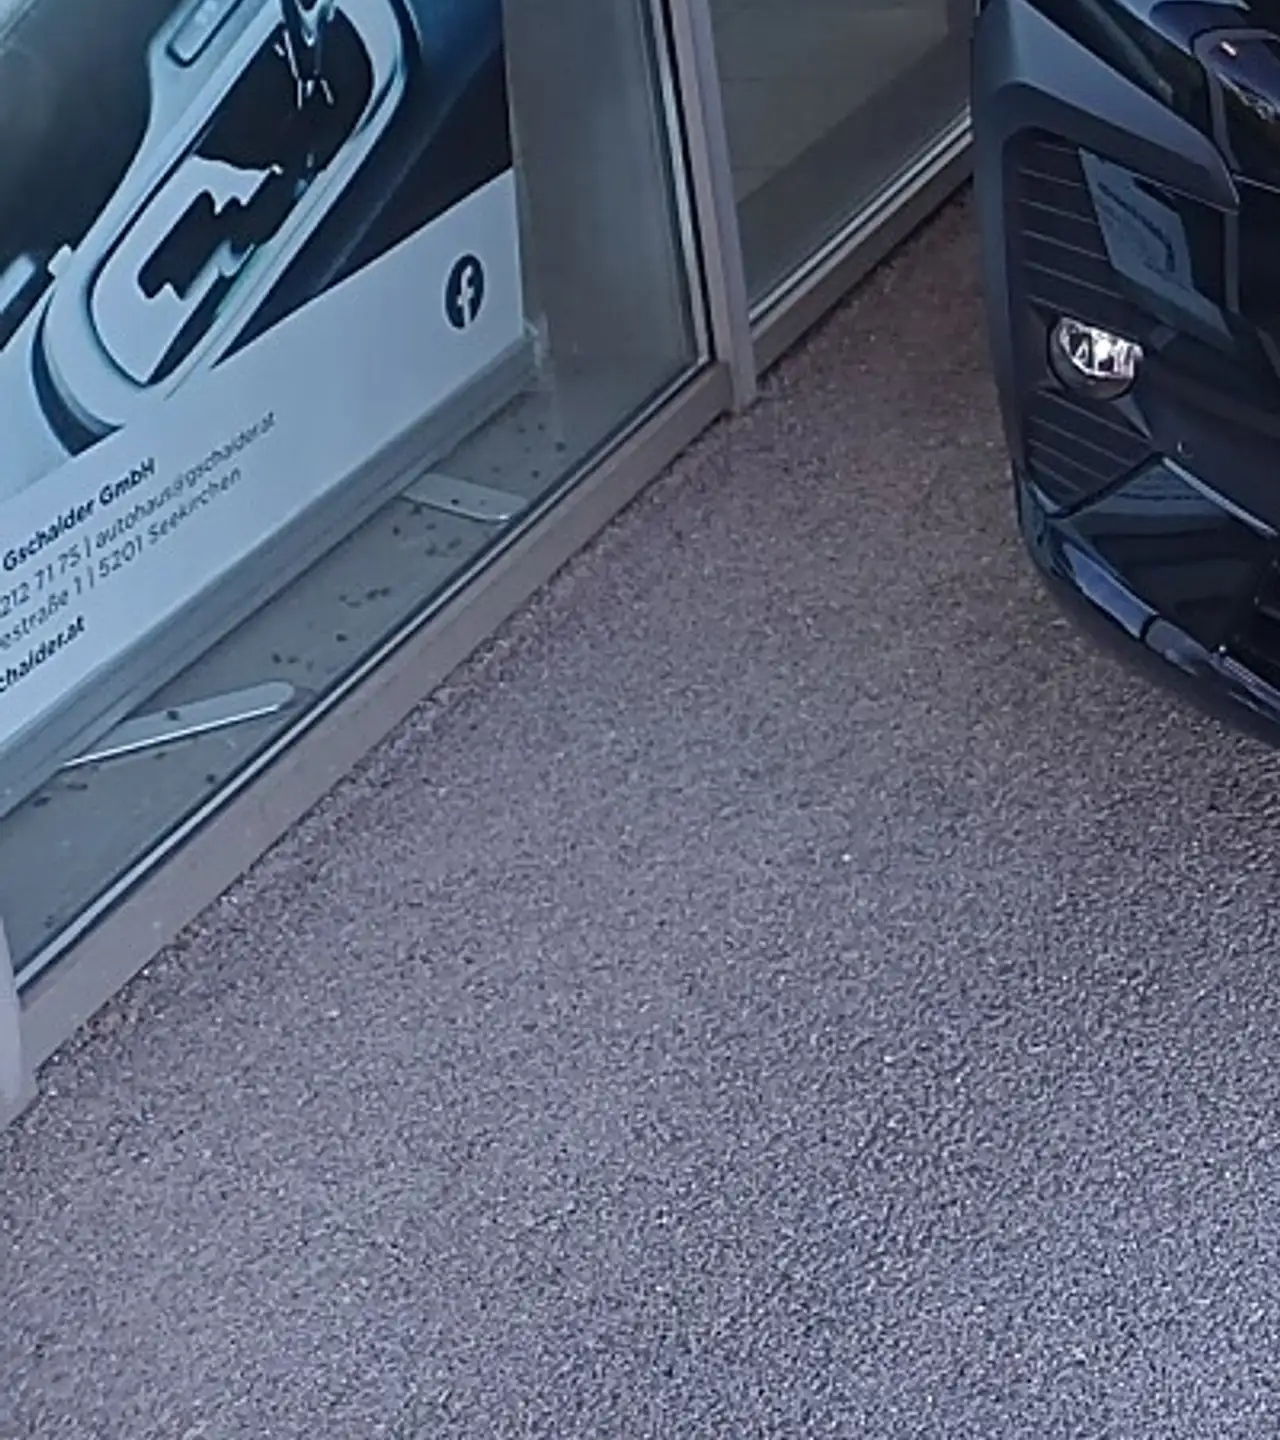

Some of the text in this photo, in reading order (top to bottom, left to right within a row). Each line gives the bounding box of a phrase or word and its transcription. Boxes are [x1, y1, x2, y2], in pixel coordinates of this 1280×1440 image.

[99, 457, 155, 506] GmbH
[99, 535, 143, 578] 5201
[148, 467, 242, 546] Seekirchen
[34, 563, 54, 590] 71
[57, 541, 83, 576] 75
